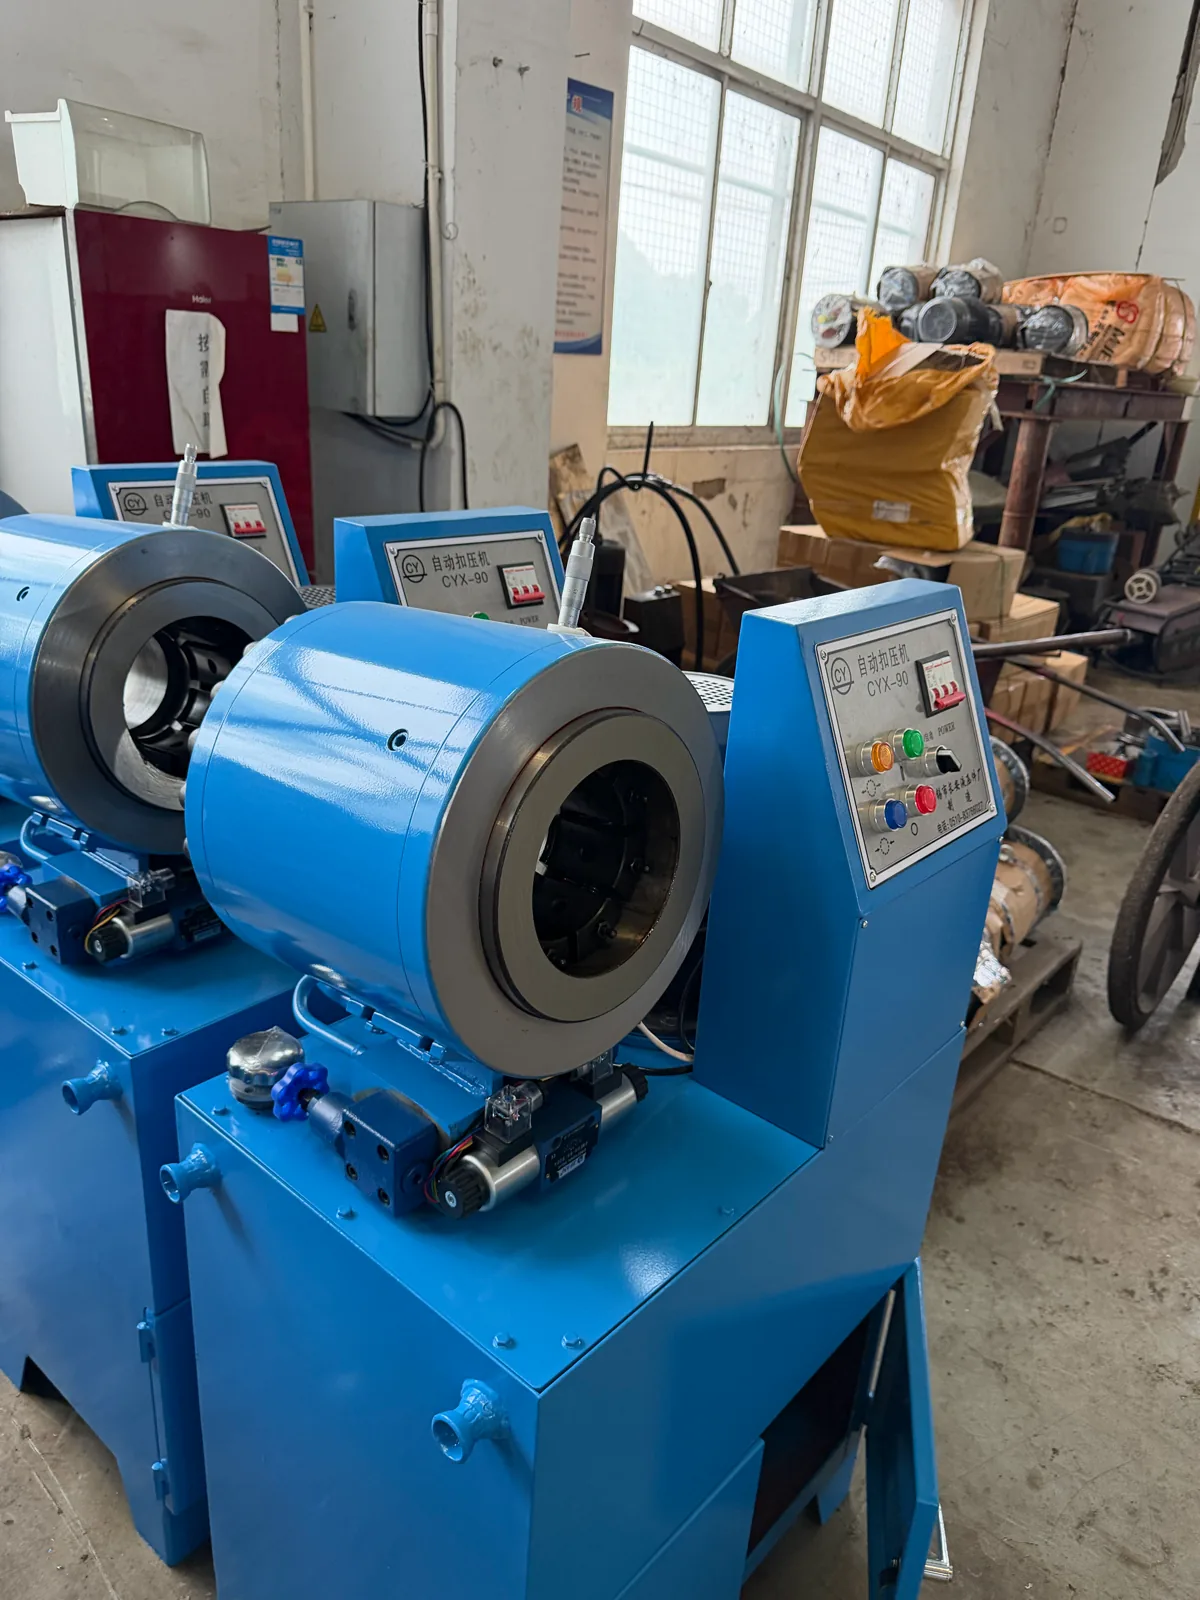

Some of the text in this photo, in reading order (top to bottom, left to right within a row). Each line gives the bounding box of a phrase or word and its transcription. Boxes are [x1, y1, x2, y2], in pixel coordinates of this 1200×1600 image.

[154, 491, 213, 507] 自动压机
[405, 562, 419, 574] CY
[432, 551, 490, 572] 自动扣压机
[442, 571, 489, 588] CYX-90
[858, 643, 910, 677] 自动扣压机
[834, 666, 847, 683] CY
[867, 670, 909, 697] CYX-90
[937, 721, 956, 736] POWER
